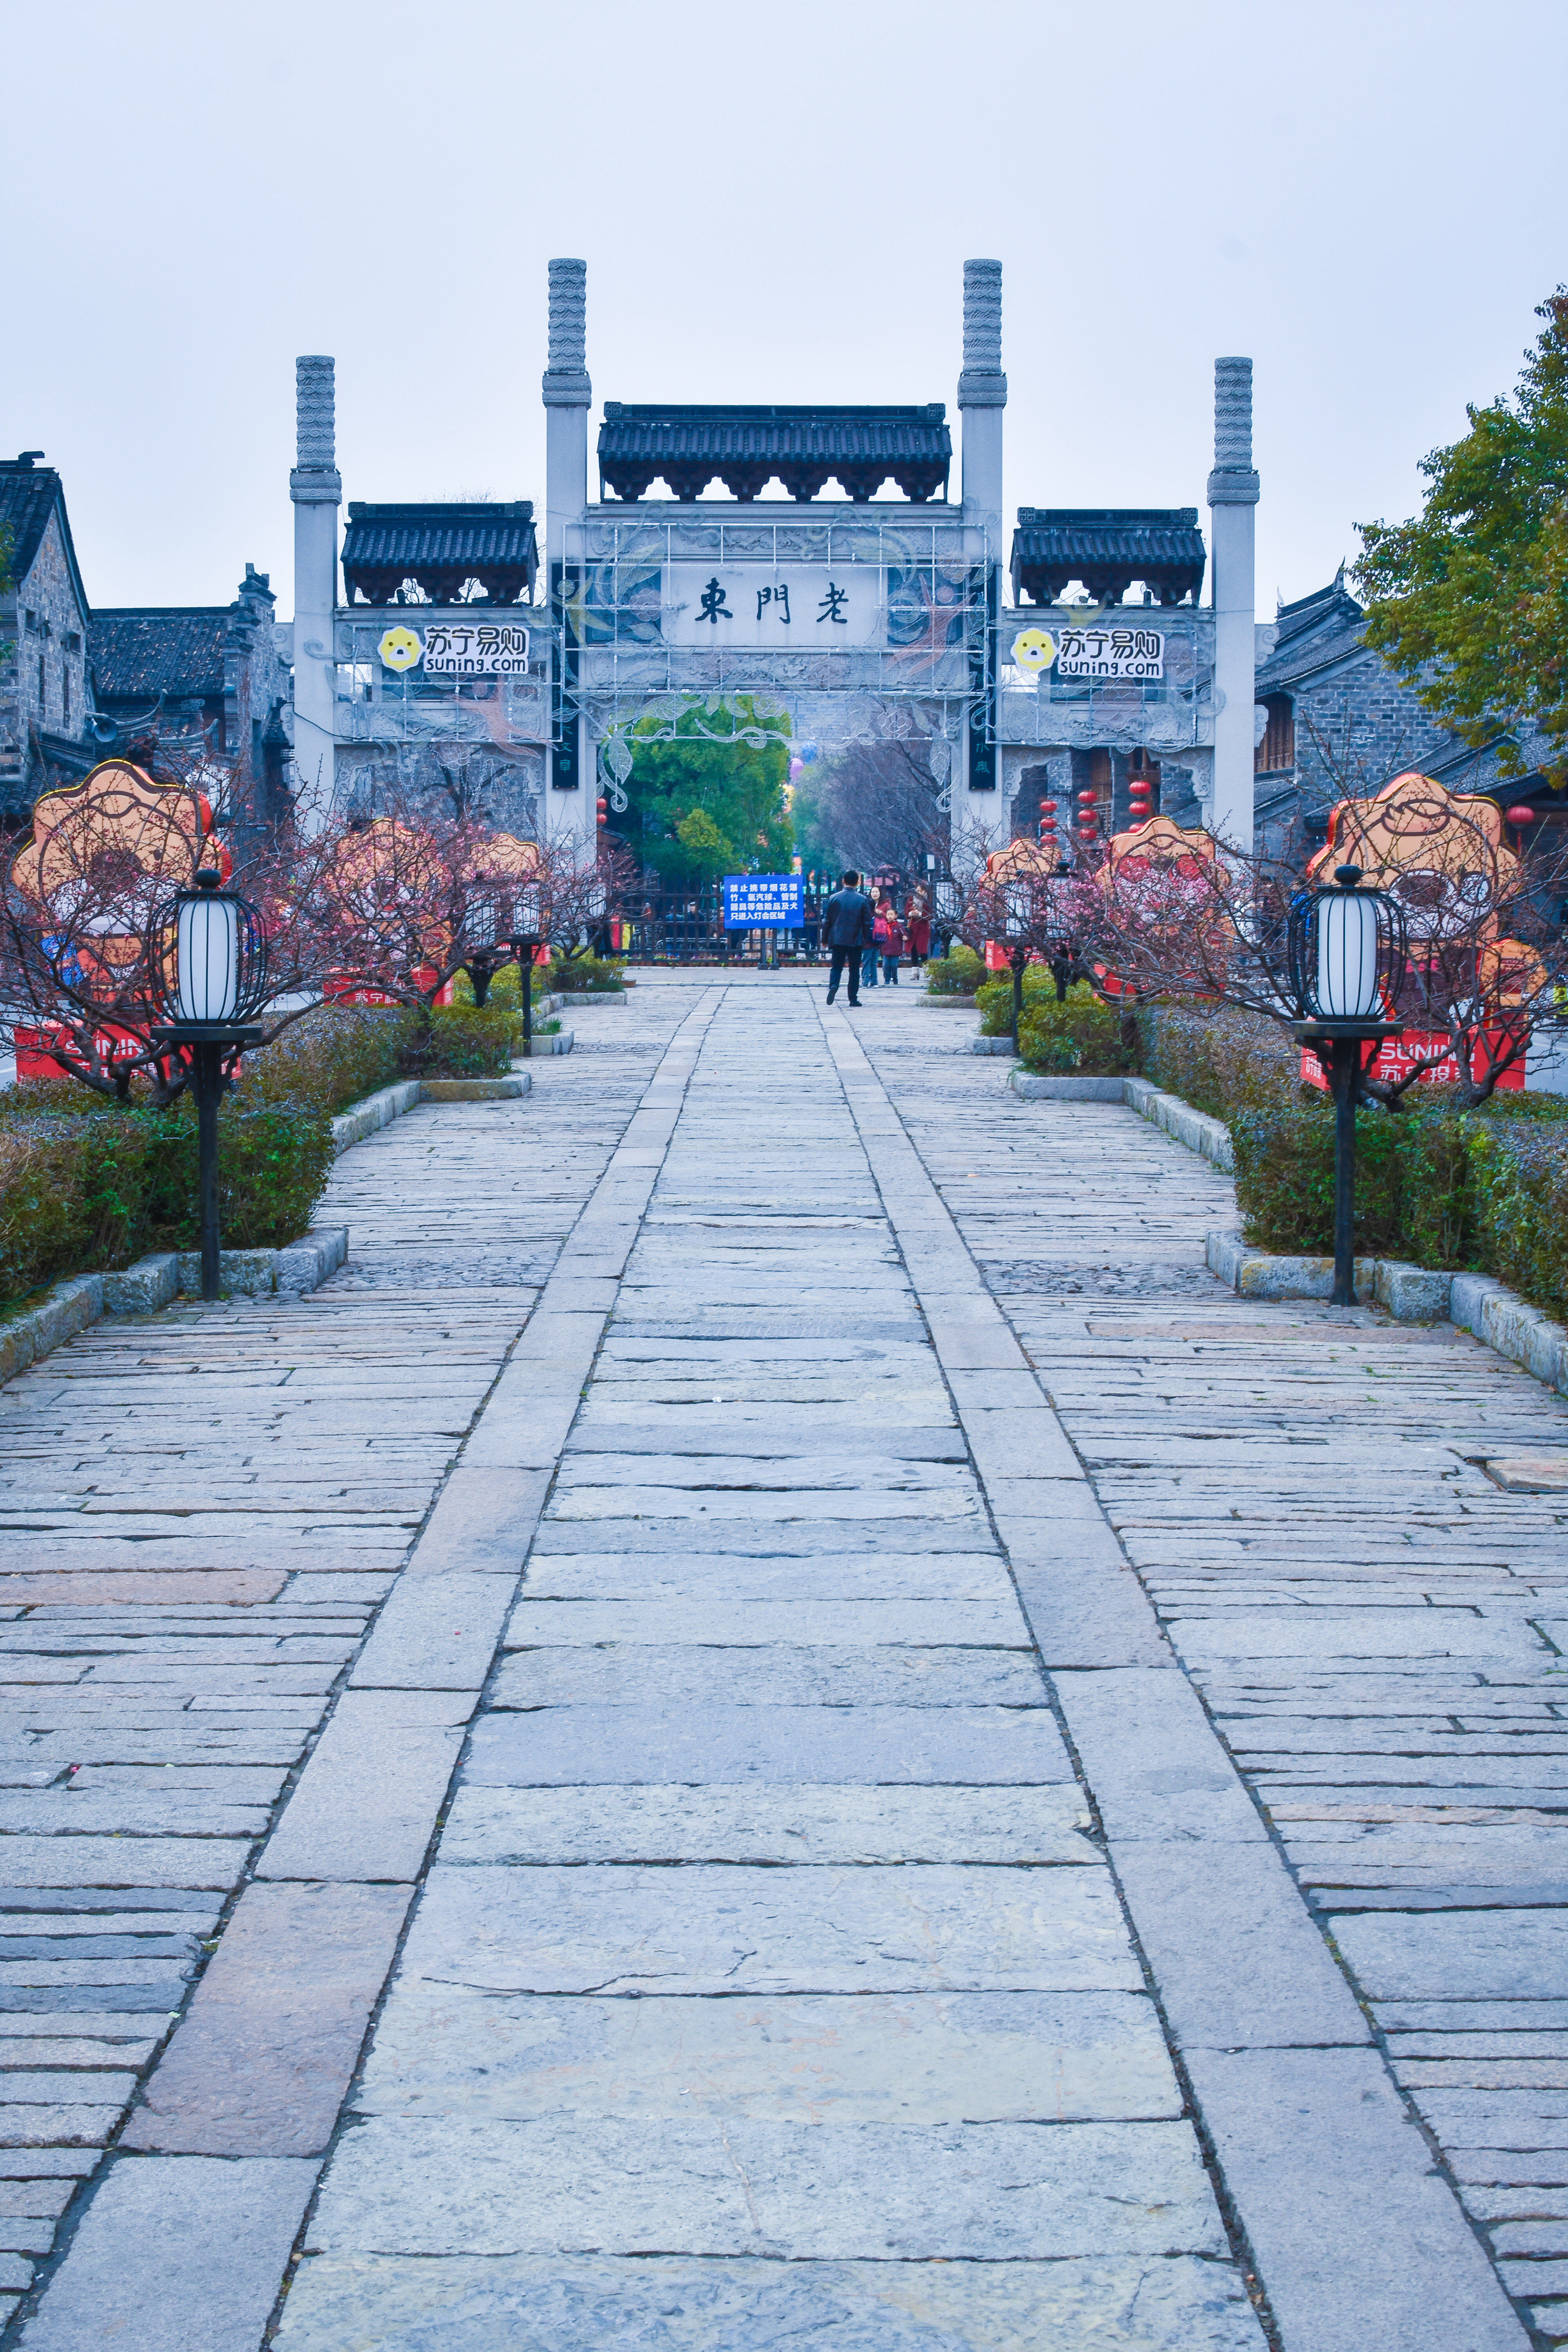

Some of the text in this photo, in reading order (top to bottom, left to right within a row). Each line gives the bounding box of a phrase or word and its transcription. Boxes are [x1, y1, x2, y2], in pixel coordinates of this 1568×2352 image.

[426, 627, 526, 655] 苏宁易购
[1060, 630, 1160, 659] 苏宁易购
[426, 659, 525, 672] suning.com
[1060, 661, 1159, 675] suning.com
[730, 883, 798, 892] 禁止携带烟花爆
[730, 902, 798, 911] 器具等危险品及犬
[730, 911, 786, 920] 只进入灯会区域
[355, 992, 401, 1004] 苏宁科
